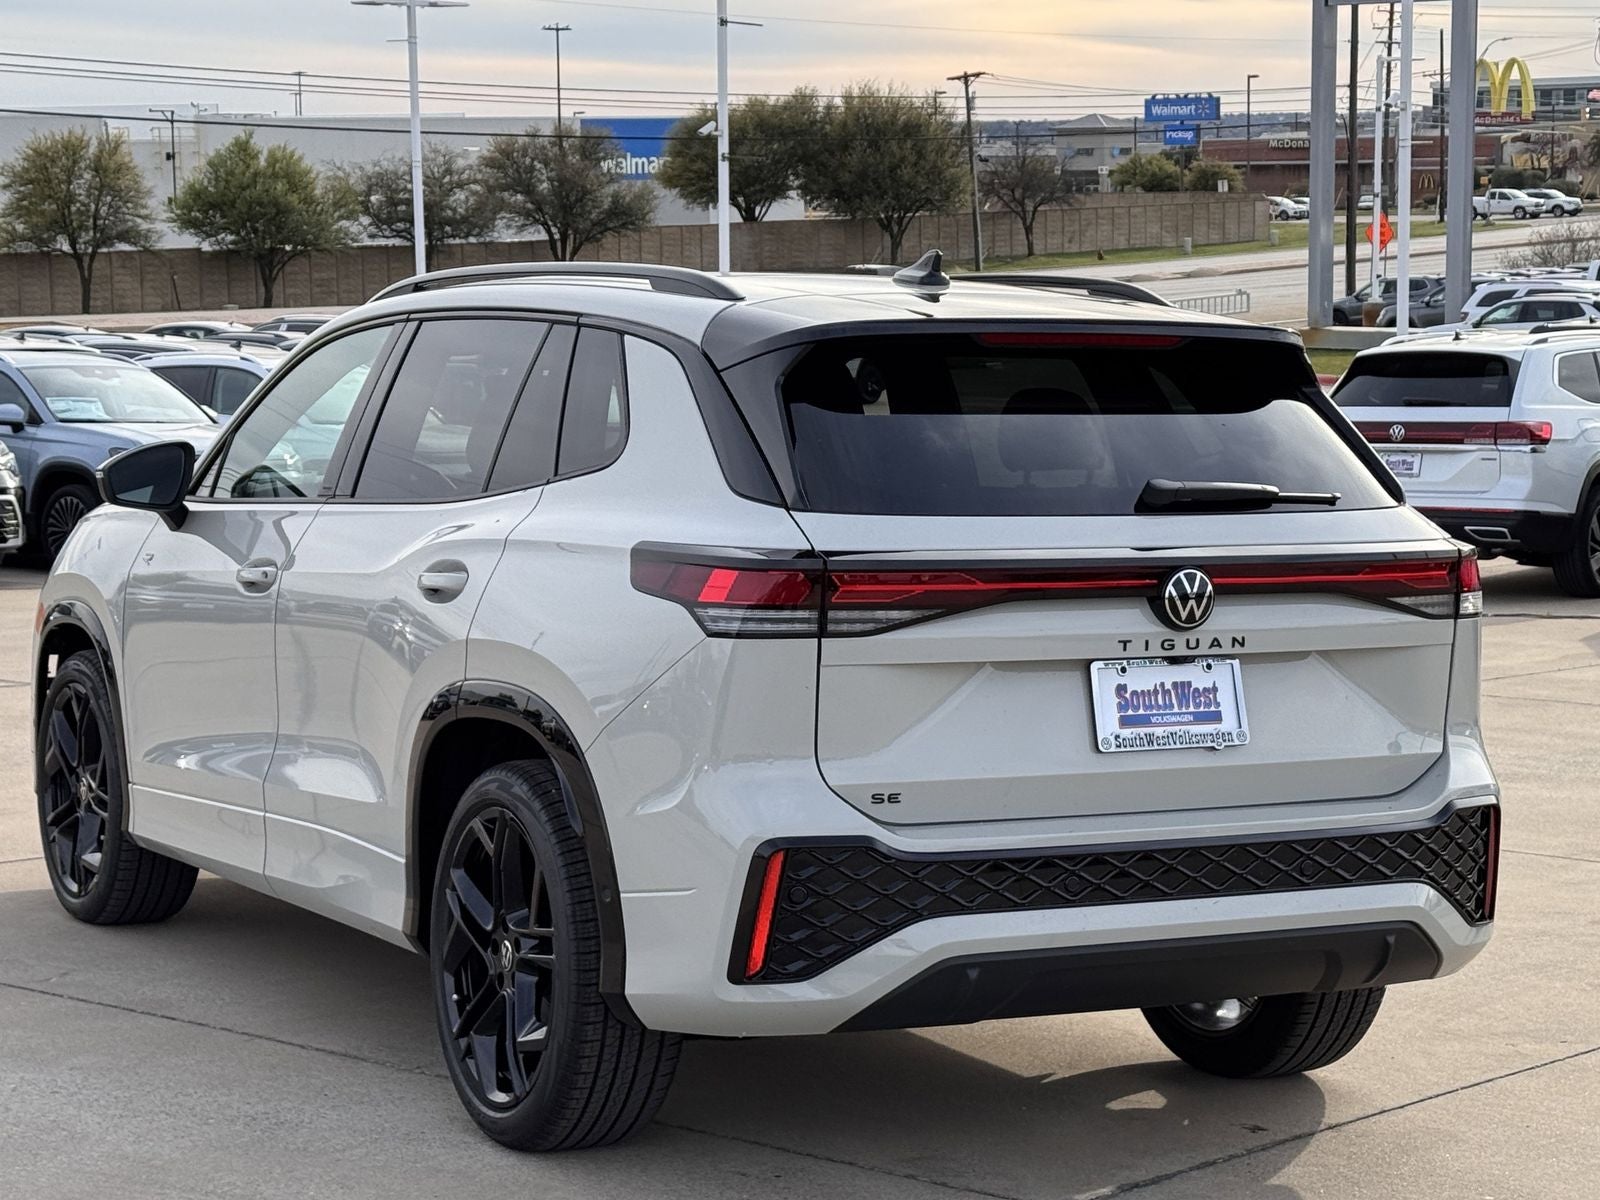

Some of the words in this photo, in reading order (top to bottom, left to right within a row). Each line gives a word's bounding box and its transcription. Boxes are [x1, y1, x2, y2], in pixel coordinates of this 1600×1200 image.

[1151, 102, 1196, 117] Walmart
[1269, 139, 1310, 149] McDona
[600, 152, 671, 175] Walmar
[1117, 636, 1247, 653] TIGUAN
[1114, 680, 1222, 714] SouthWest
[1150, 713, 1195, 724] VOLKSWAGEN
[1114, 729, 1235, 749] SouthWestVolkswagen
[870, 792, 902, 805] SE
